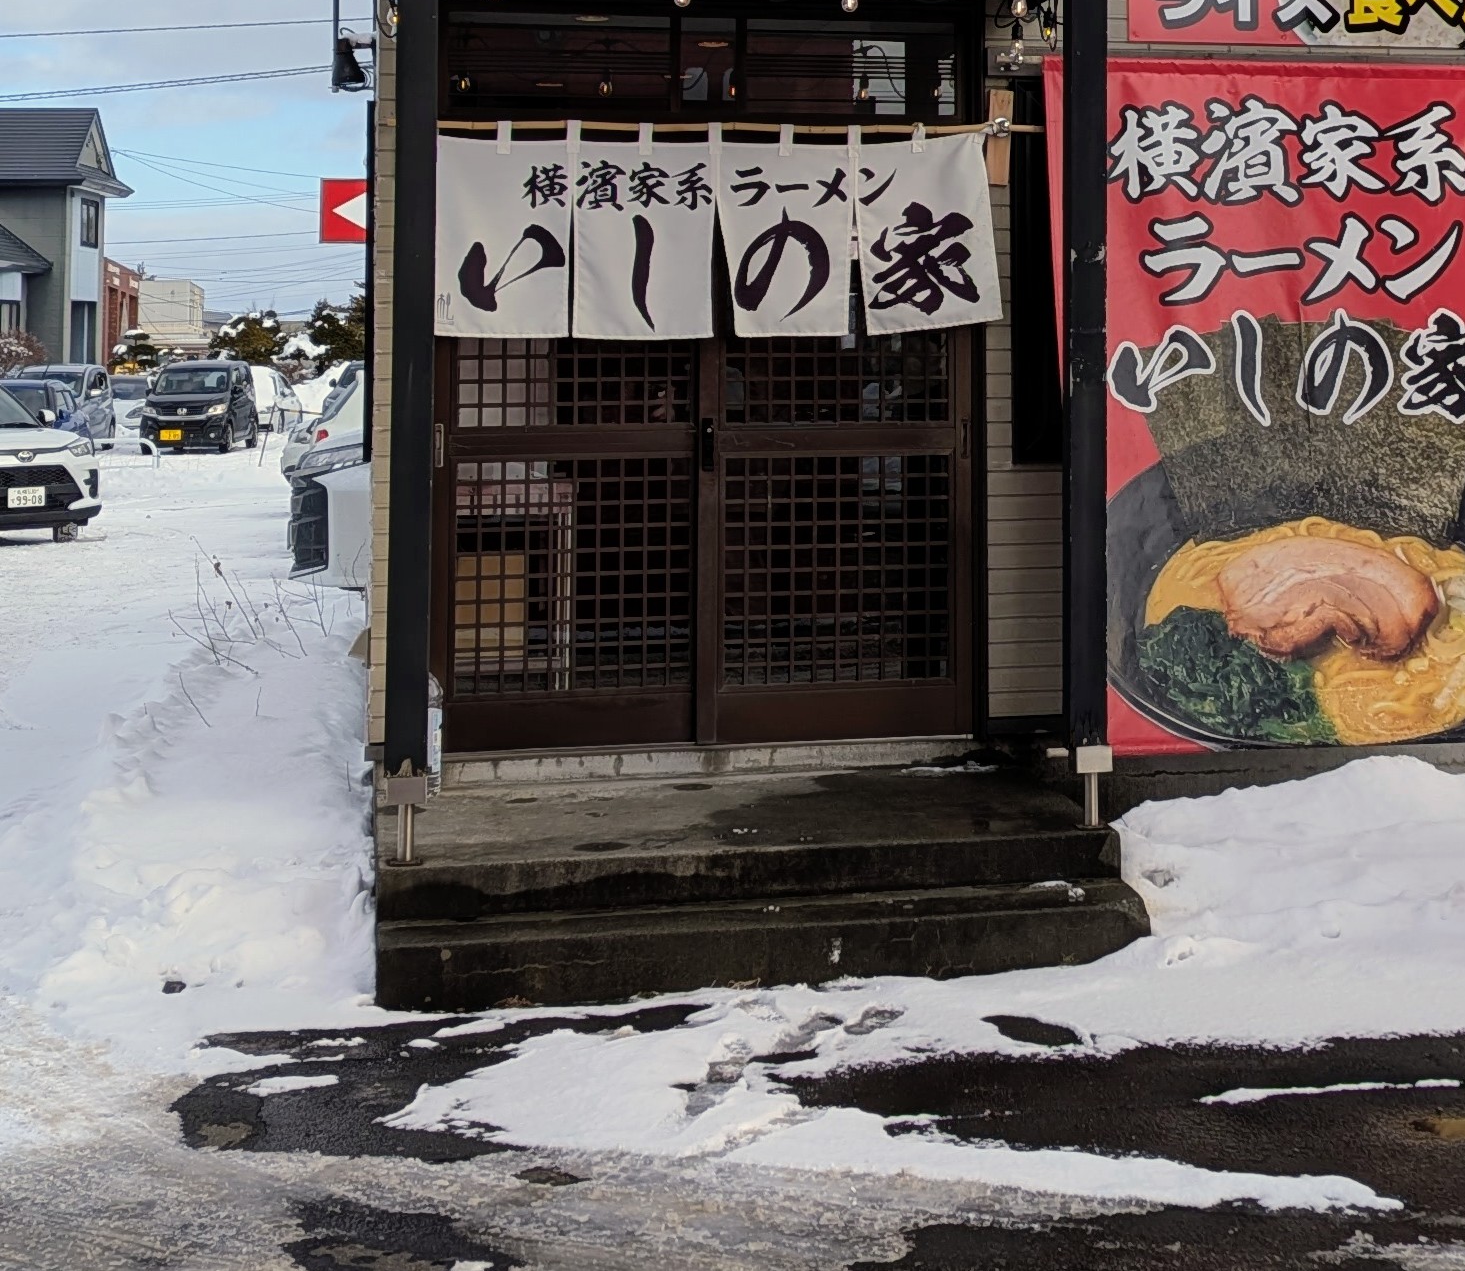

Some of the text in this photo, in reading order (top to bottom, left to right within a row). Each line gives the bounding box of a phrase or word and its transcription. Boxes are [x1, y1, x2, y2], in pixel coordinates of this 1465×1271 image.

[522, 161, 897, 211] 横濱家系 ラーメン
[457, 201, 981, 332] いしの家
[1143, 212, 1463, 305] ラーメン
